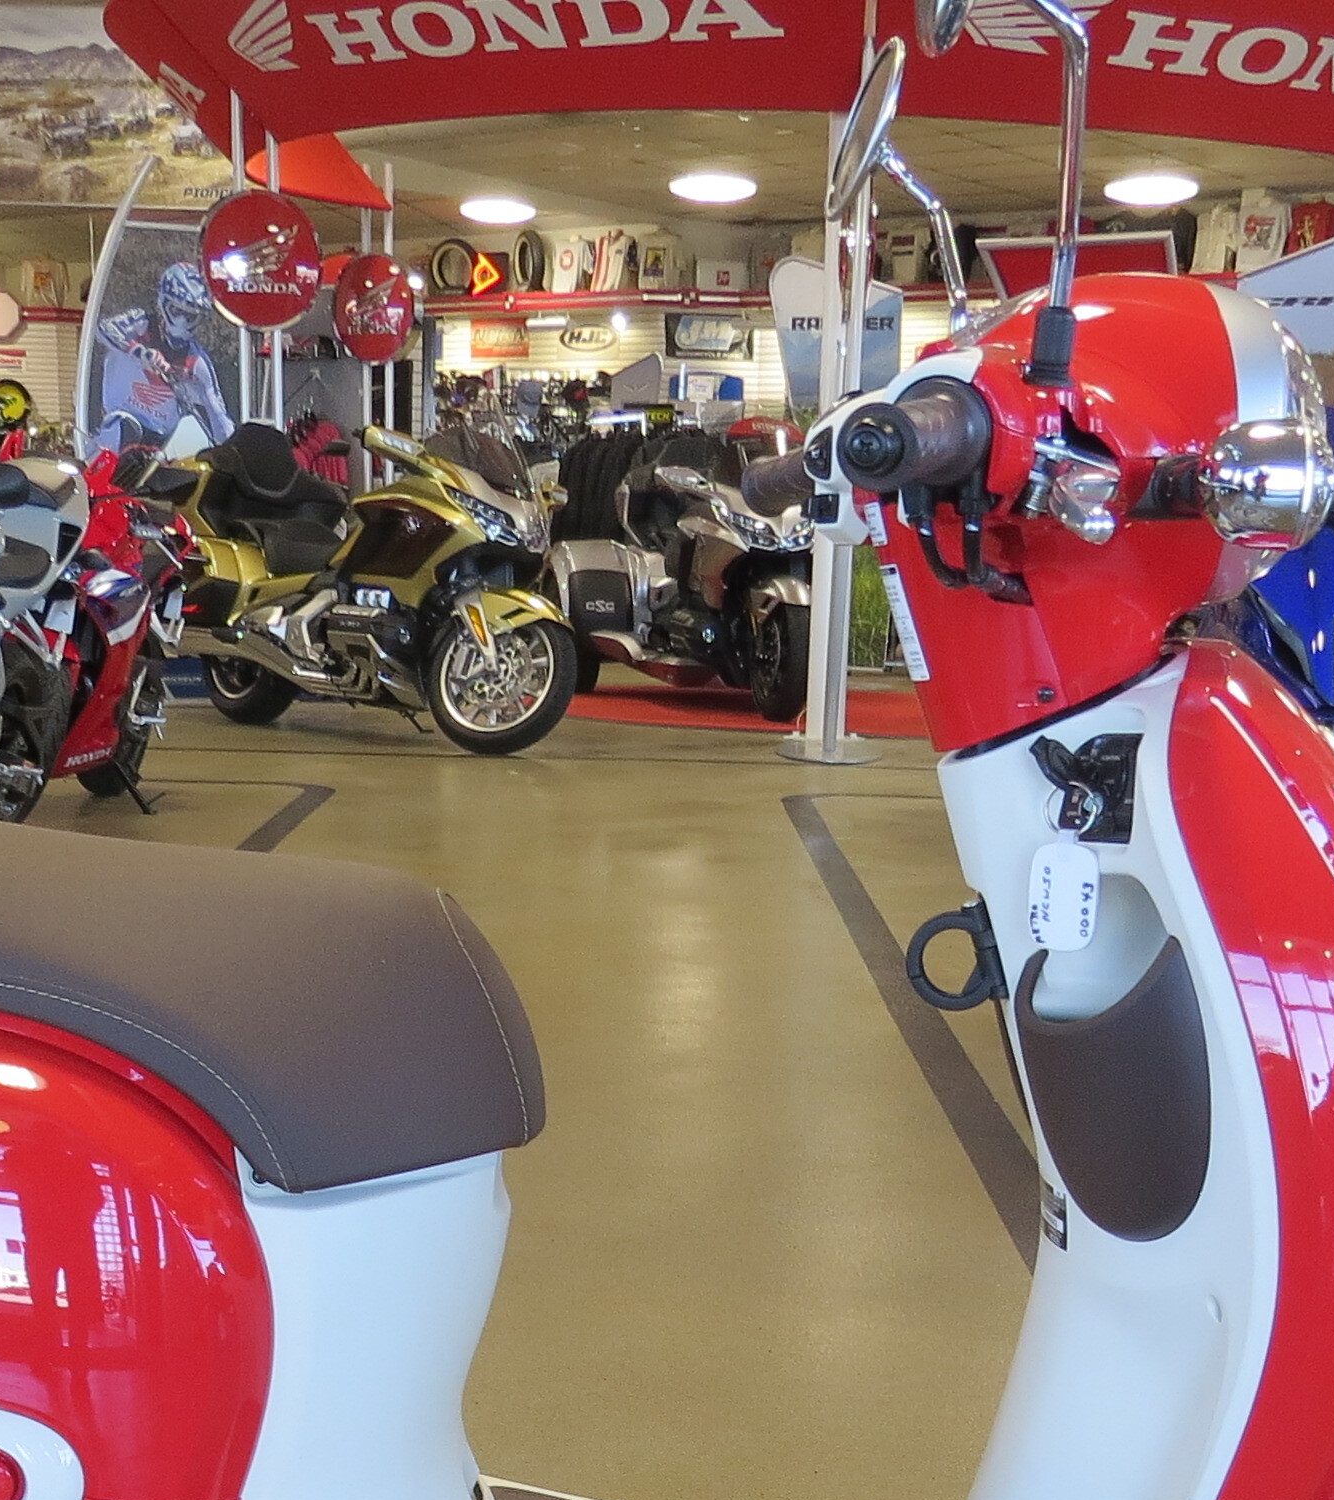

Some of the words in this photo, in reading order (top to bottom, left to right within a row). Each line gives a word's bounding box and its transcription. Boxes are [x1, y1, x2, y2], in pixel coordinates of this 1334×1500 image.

[305, 0, 785, 65] HONDA
[227, 280, 302, 296] HONDA
[791, 316, 895, 331] RAER
[569, 329, 610, 344] HJC
